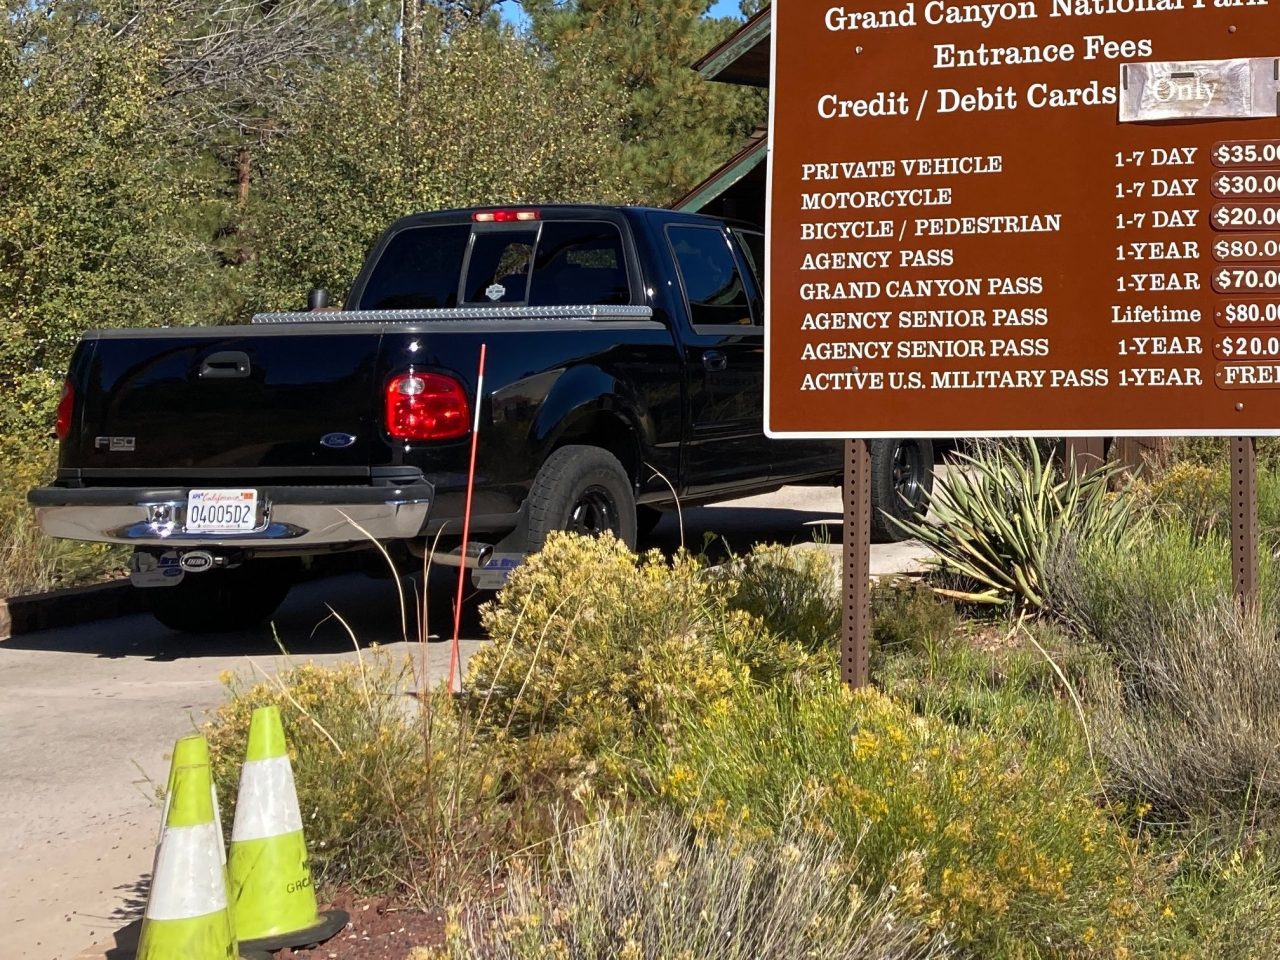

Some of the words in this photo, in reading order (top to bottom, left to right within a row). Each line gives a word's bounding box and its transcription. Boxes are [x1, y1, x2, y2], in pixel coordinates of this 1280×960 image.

[825, 3, 916, 31] Grand
[925, 1, 1037, 28] Canyon
[934, 44, 1074, 68] Entrance
[1084, 36, 1152, 59] Fees
[818, 92, 908, 118] Credit
[916, 90, 928, 121] /
[937, 86, 1017, 112] Debit
[1027, 81, 1116, 107] Cards
[1152, 76, 1219, 107] Only
[802, 161, 895, 180] PRIVATE
[901, 156, 1001, 175] VEHICLE
[1116, 151, 1144, 166] 1-7
[1151, 148, 1197, 165] DAY
[801, 188, 951, 209] MOTORCYCLE
[1116, 183, 1145, 197] 1-7
[1152, 179, 1198, 196] DAY
[801, 221, 893, 239] BICYCLE
[896, 218, 909, 244] /
[915, 215, 1061, 235] PEDESTRIAN
[1117, 214, 1145, 228] 1-7
[1152, 210, 1199, 227] DAY
[800, 251, 892, 269] AGENCY
[900, 249, 953, 266] PASS
[1117, 242, 1199, 260] 1-YEAR
[800, 282, 880, 300] GRAND
[886, 279, 982, 297] CANYON
[988, 277, 1042, 294] PASS
[1118, 273, 1200, 291] 1-YEAR
[801, 312, 892, 329] AGENCY
[899, 310, 986, 327] SENIOR
[993, 309, 1047, 326] PASS
[1112, 305, 1201, 322] Lifetime
[801, 342, 893, 359] AGENCY
[898, 340, 985, 358] SENIOR
[990, 339, 1048, 356] PASS
[1119, 337, 1202, 354] 1-YEAR
[801, 373, 883, 390] ACTIVE
[888, 372, 925, 389] U.S.
[931, 371, 1046, 388] MILITARY
[1051, 369, 1108, 387] PASS
[1119, 369, 1202, 385] 1-YEAR
[203, 492, 241, 504] California
[191, 505, 251, 523] 04005D2
